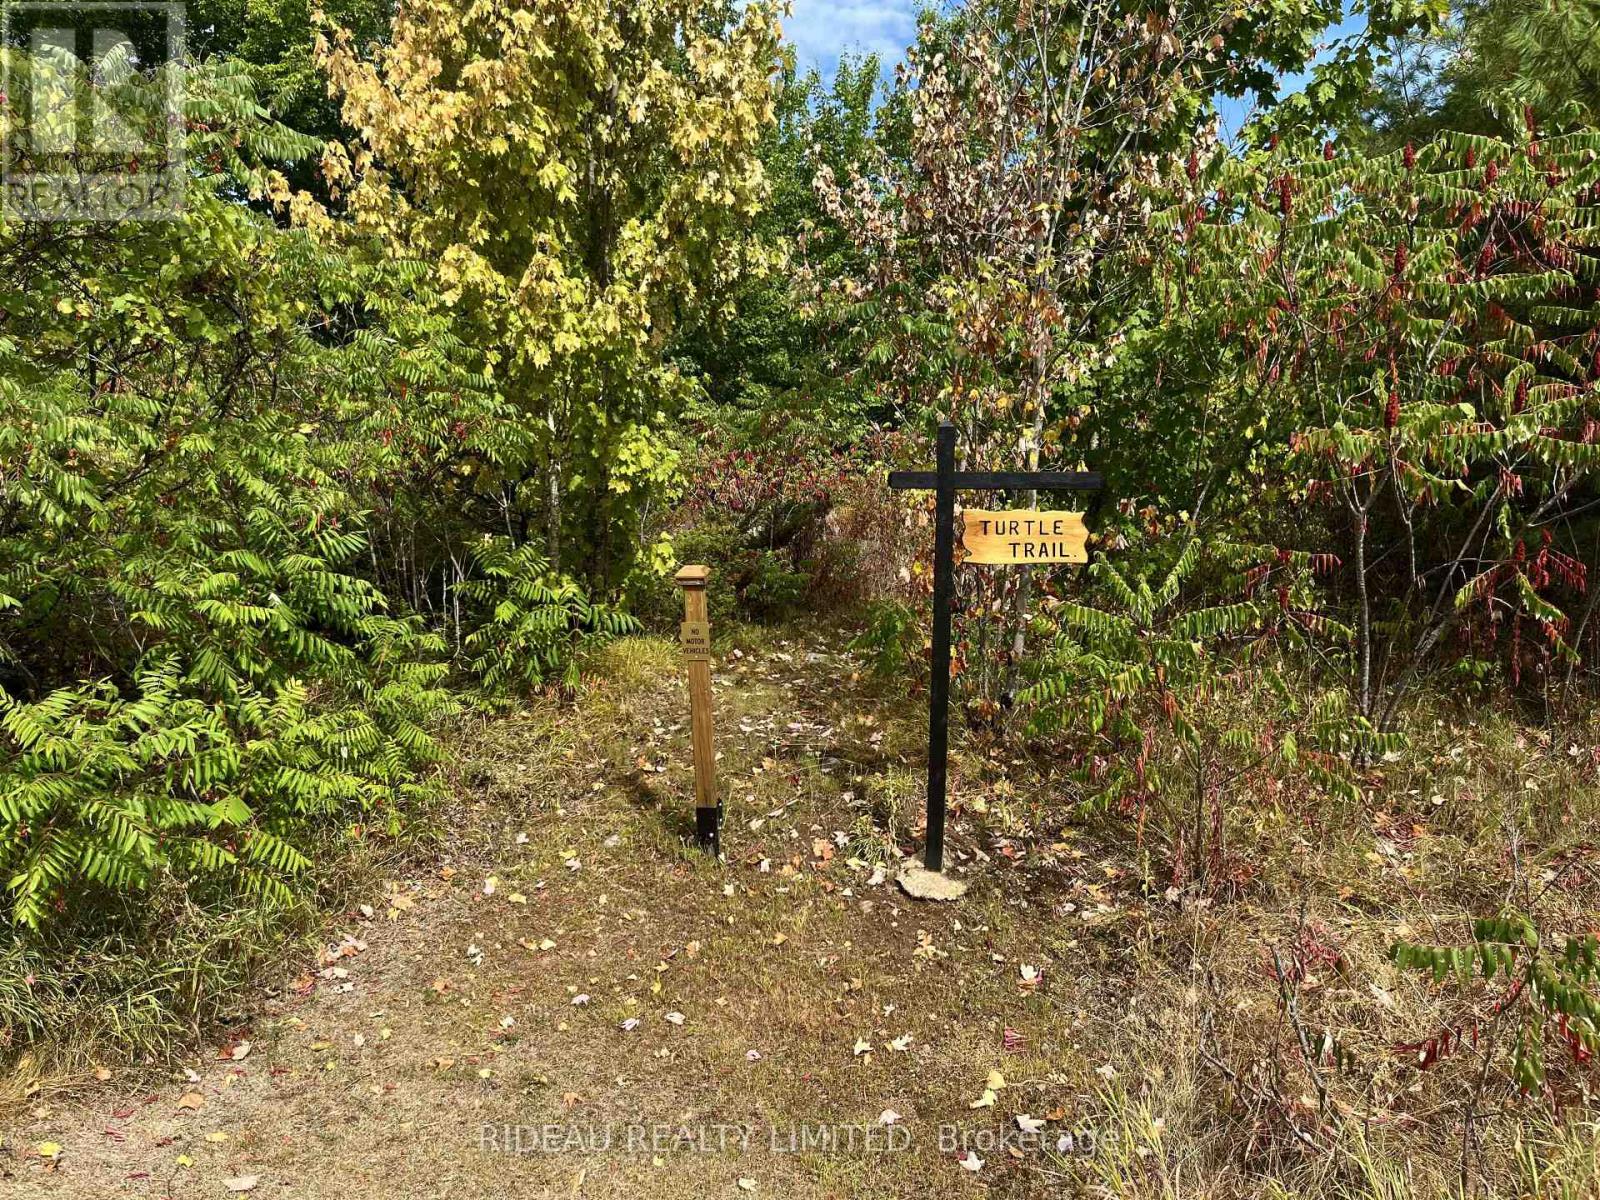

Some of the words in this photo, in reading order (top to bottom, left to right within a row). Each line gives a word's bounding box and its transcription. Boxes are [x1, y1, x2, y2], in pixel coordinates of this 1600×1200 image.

[979, 519, 1064, 536] TURTLE
[1008, 542, 1077, 558] TRAIL.
[682, 647, 709, 655] VEHICLES
